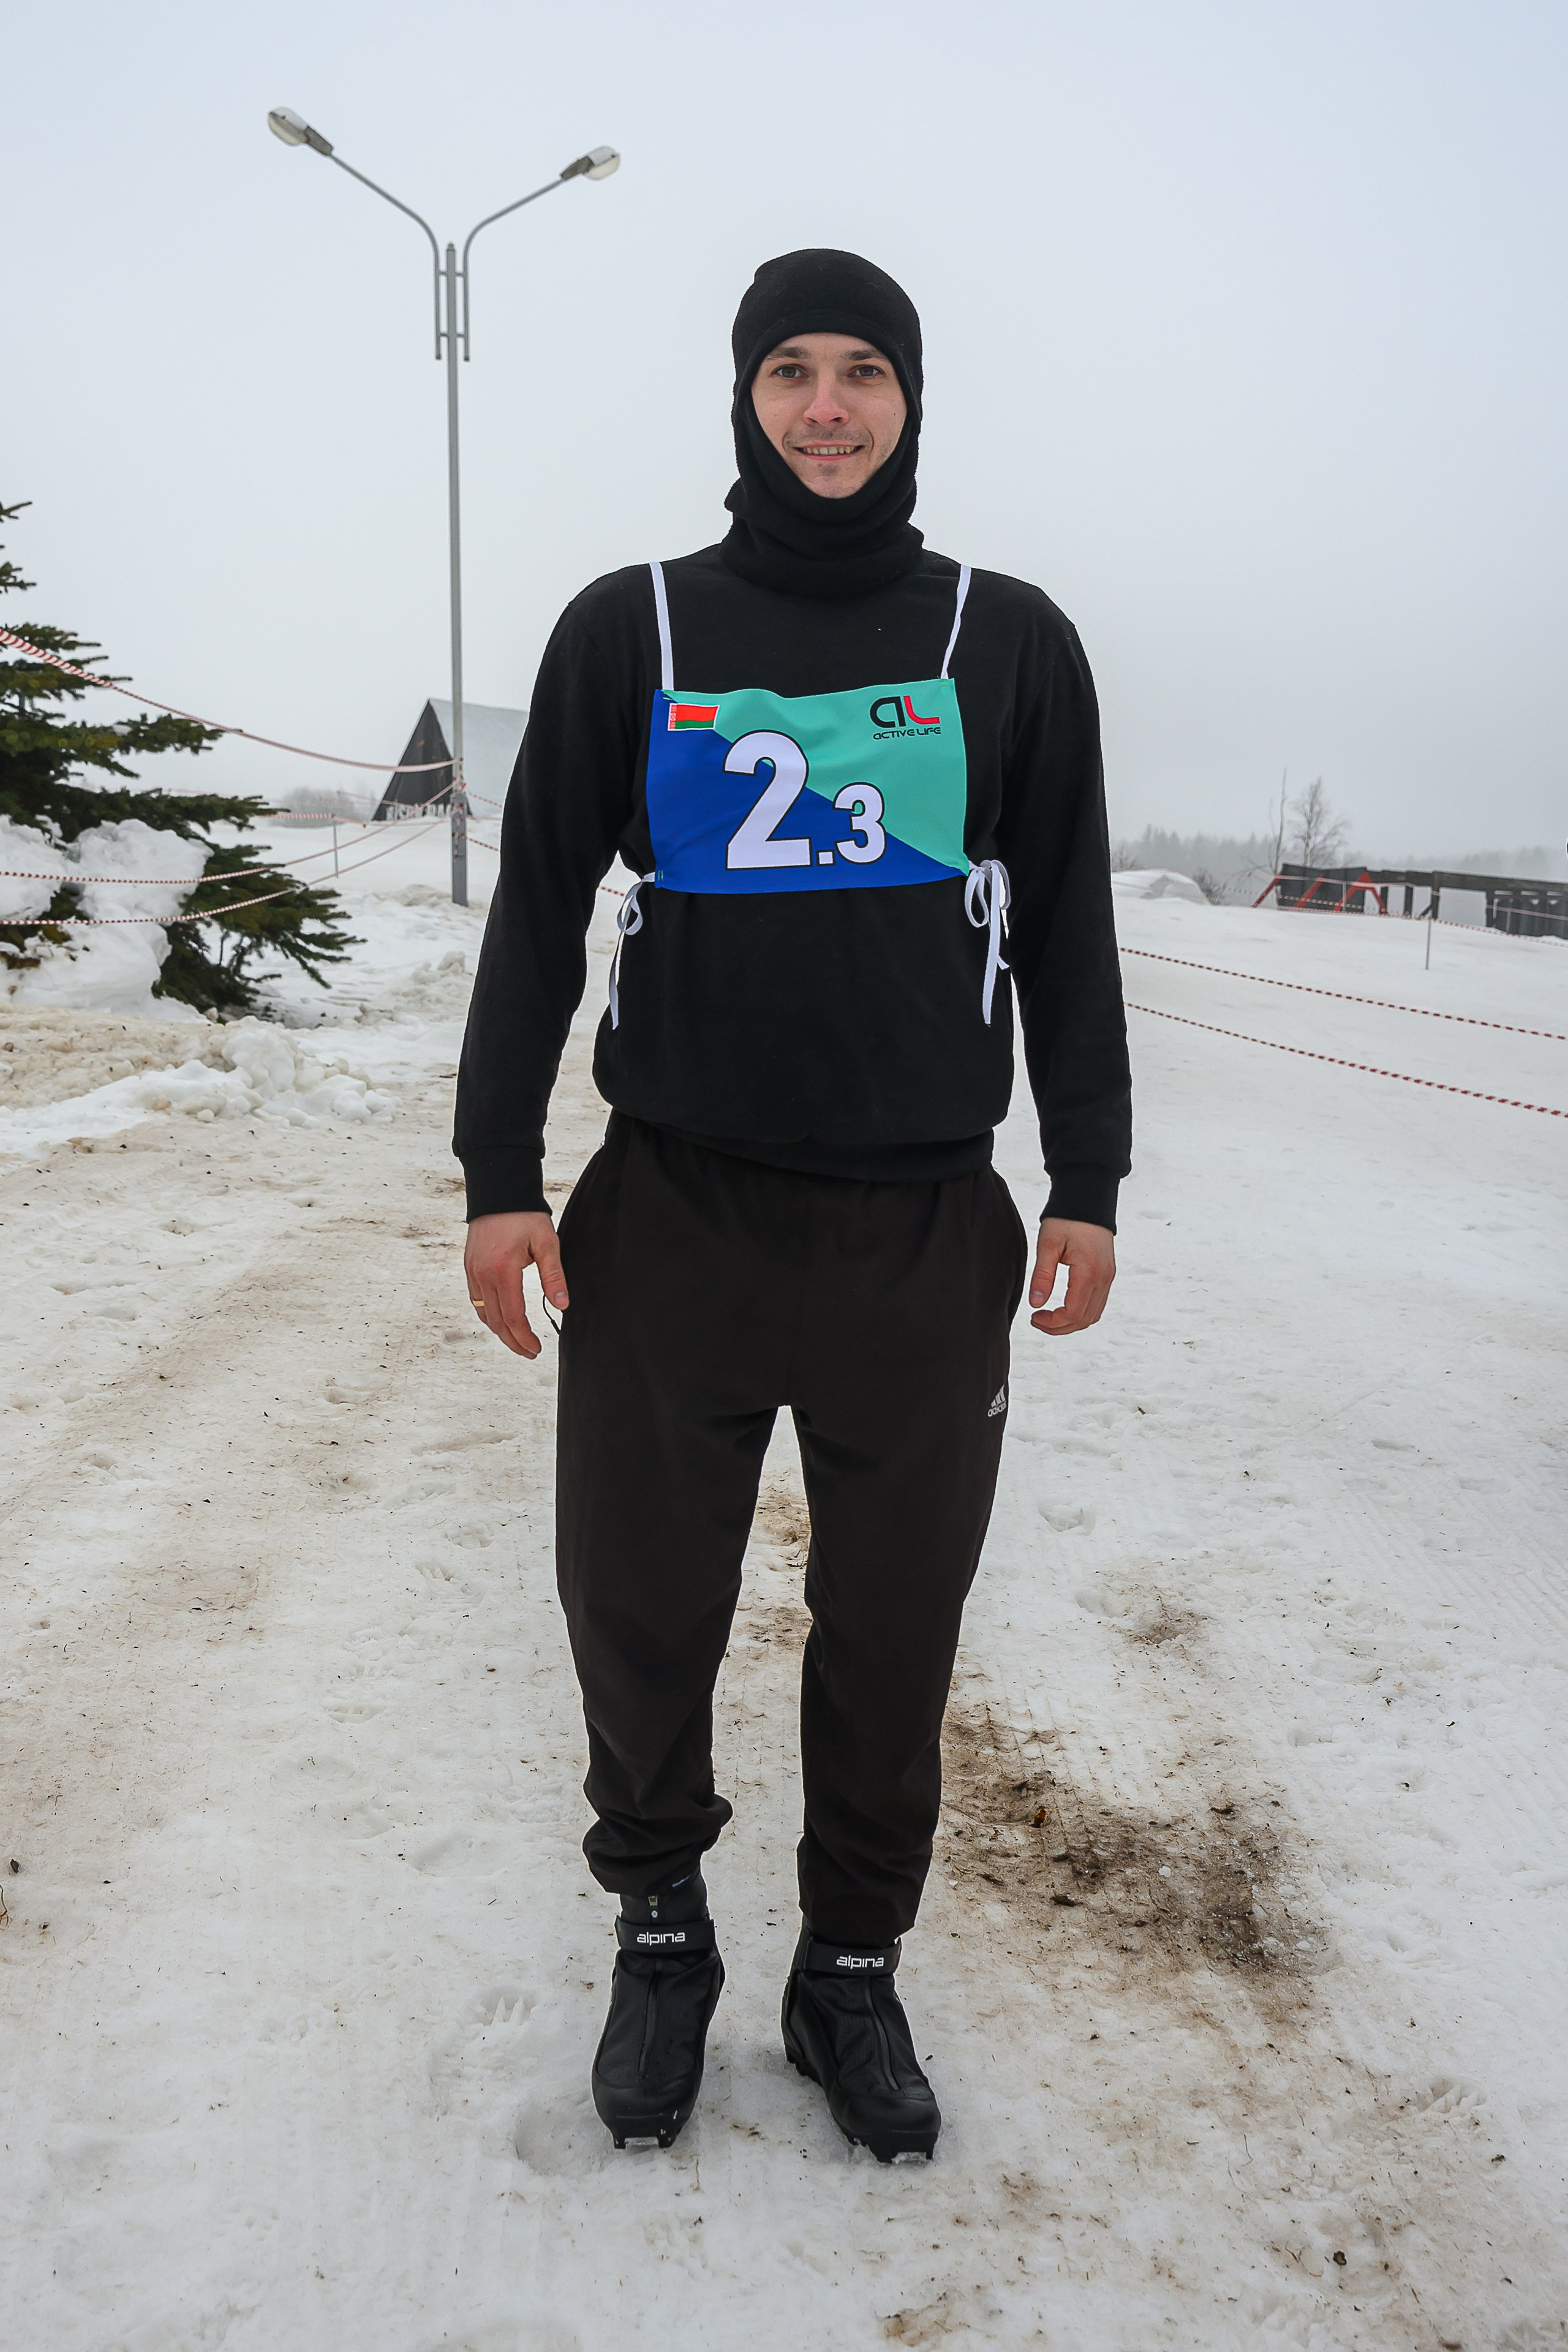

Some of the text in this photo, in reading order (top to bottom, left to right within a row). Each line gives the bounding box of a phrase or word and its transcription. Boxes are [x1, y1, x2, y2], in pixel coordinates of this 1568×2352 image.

[873, 727, 941, 740] ACTIVE LIFE
[723, 729, 887, 871] 2.3
[637, 1931, 685, 1946] alpina
[836, 1954, 884, 1969] alpina
